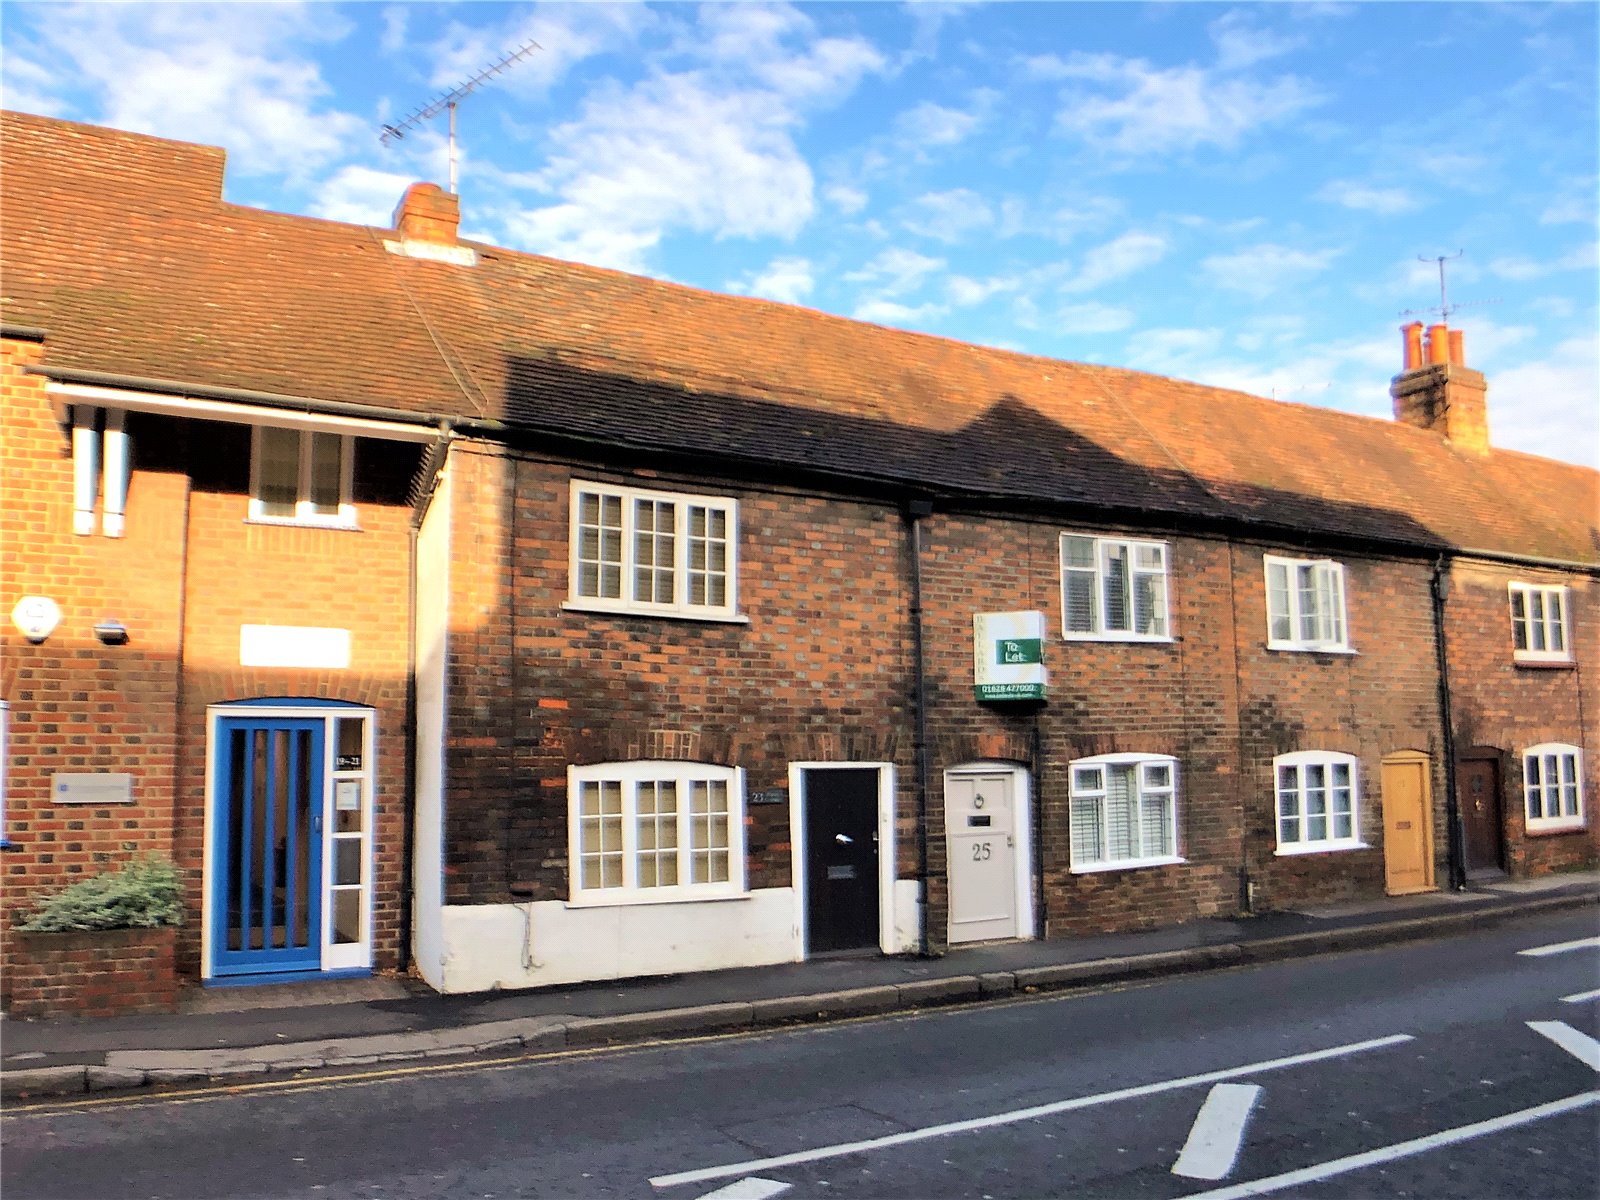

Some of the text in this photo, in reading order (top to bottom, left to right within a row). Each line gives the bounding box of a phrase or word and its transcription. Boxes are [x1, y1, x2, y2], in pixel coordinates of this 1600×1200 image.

[1004, 641, 1019, 652] To
[1005, 651, 1026, 662] Let
[972, 842, 991, 862] 25
